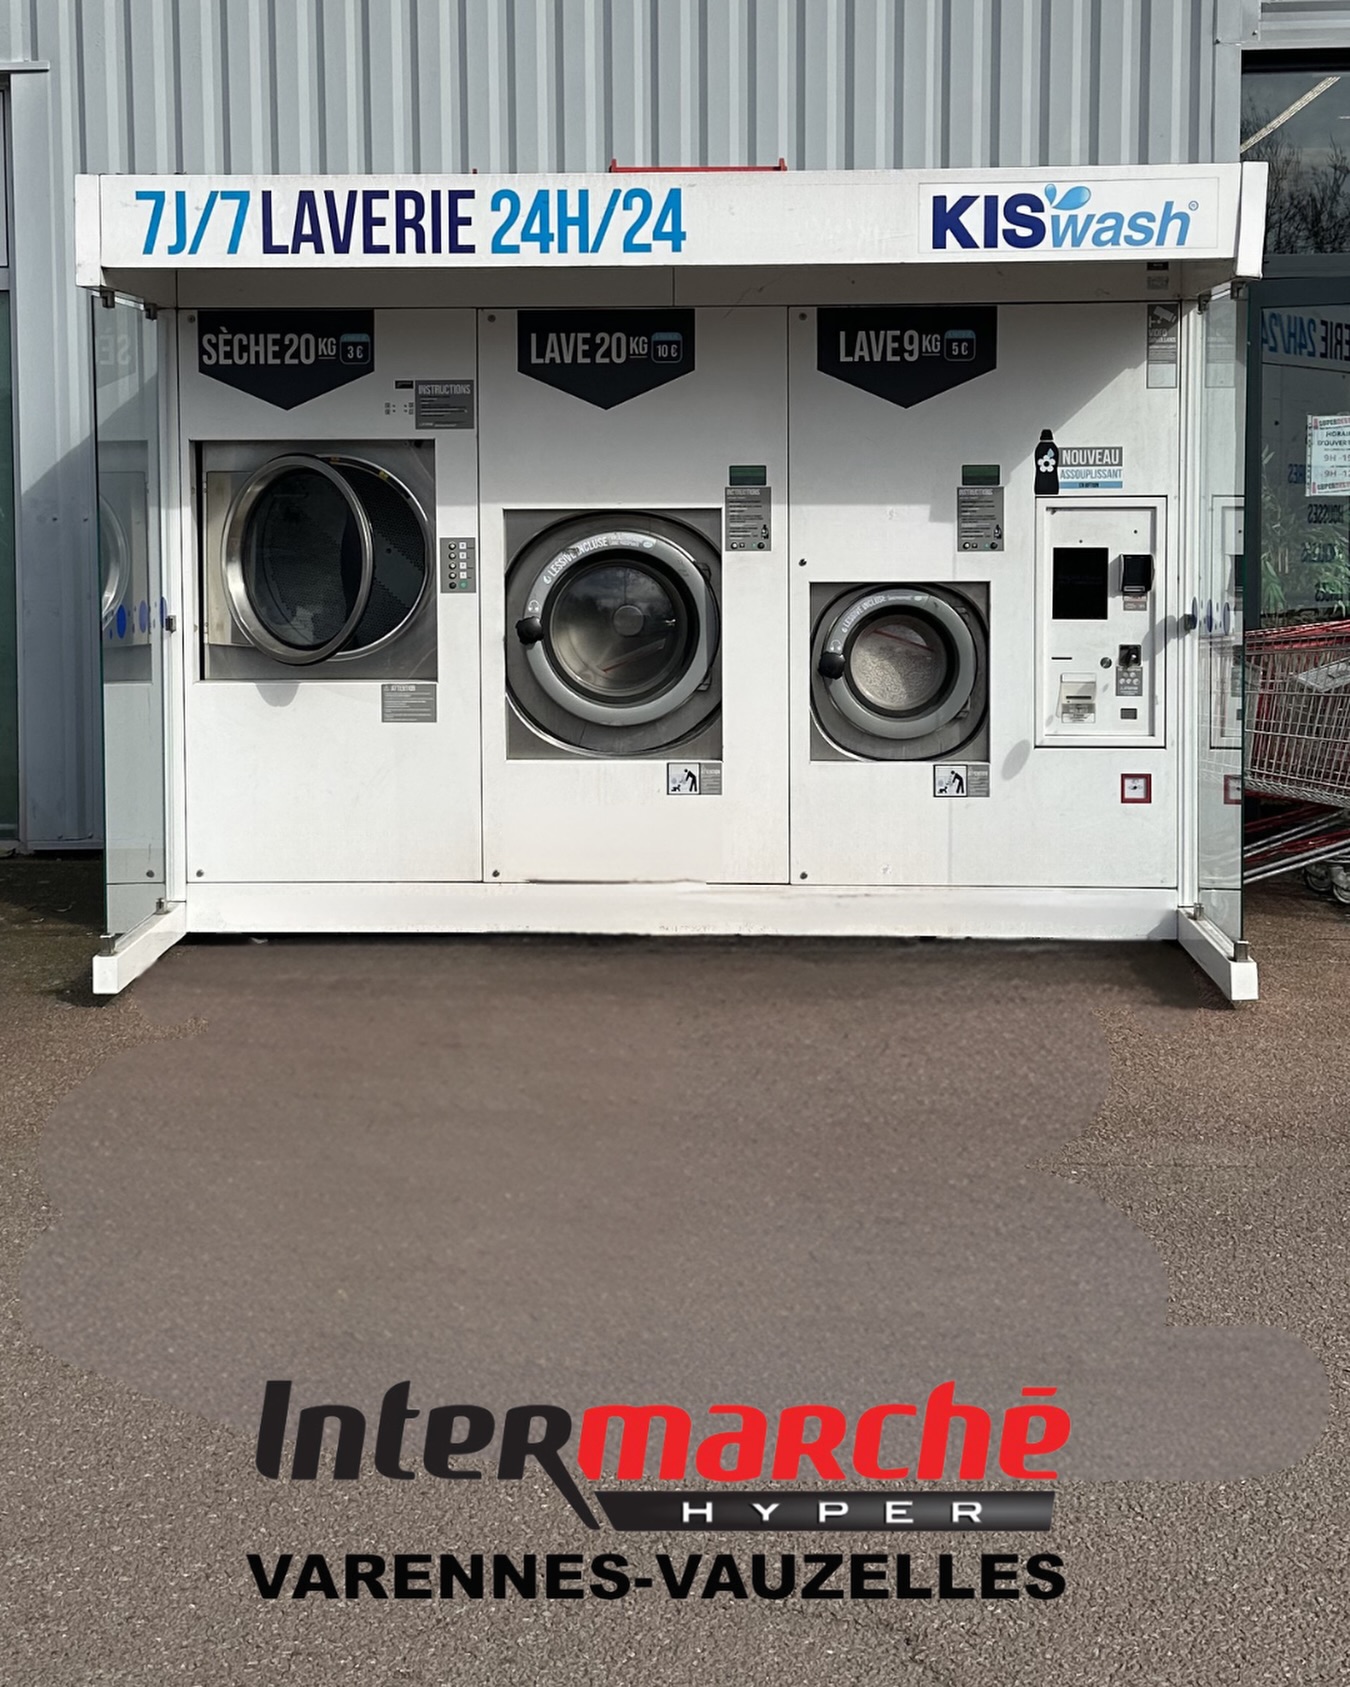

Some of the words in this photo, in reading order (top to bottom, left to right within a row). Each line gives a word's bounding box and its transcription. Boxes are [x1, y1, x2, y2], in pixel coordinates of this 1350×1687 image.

[135, 190, 250, 255] 7J/7
[261, 189, 476, 255] LAVERIE
[491, 188, 687, 254] 24H/24
[530, 332, 591, 363] LAVE
[1062, 449, 1119, 465] NOUVEAU
[1060, 468, 1122, 480] ASSOUPLISSANT
